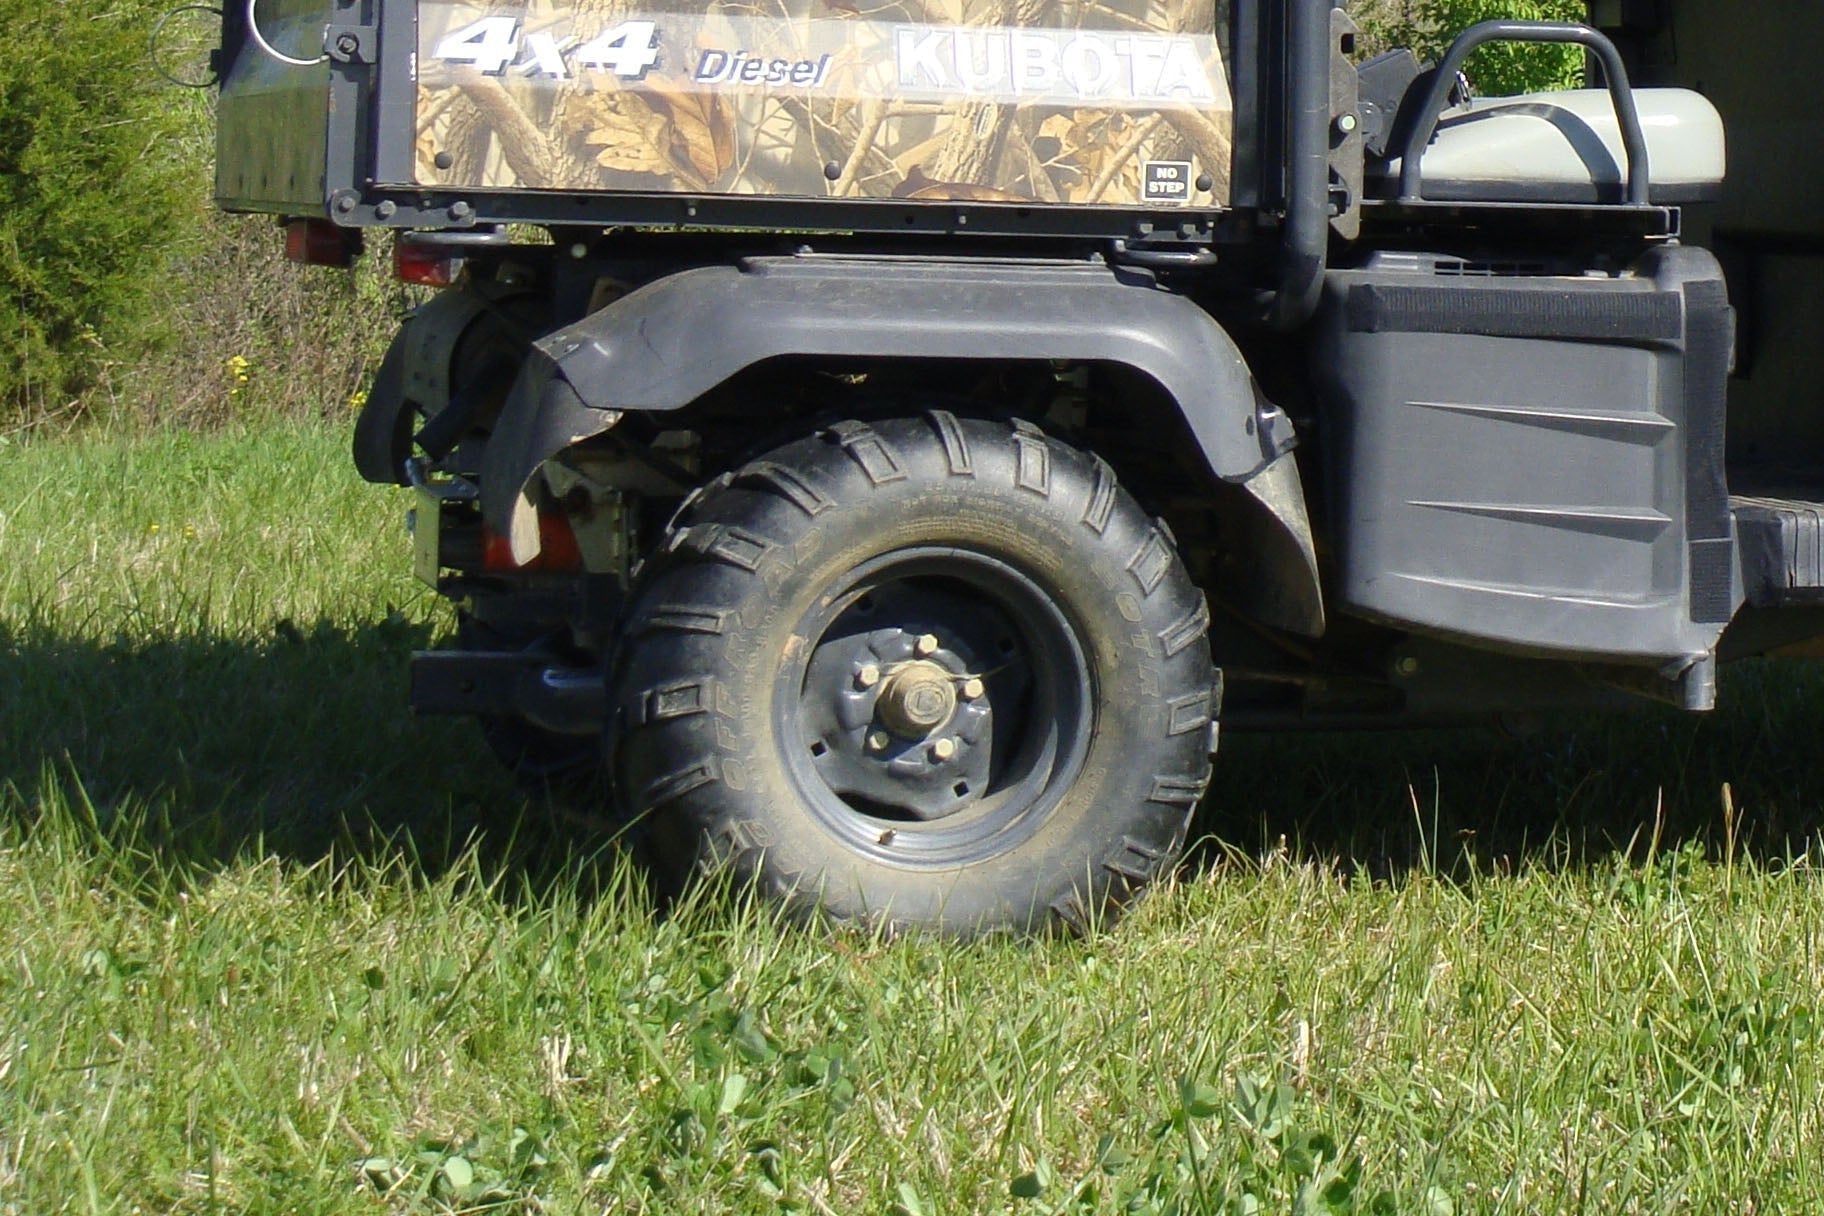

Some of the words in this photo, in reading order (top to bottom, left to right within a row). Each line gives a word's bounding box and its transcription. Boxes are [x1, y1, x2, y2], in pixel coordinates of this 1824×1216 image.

[432, 15, 660, 82] 4x4
[696, 47, 833, 89] Diesel
[896, 27, 1217, 103] KUBOTA
[1148, 181, 1185, 193] STEP
[1156, 167, 1178, 179] NO
